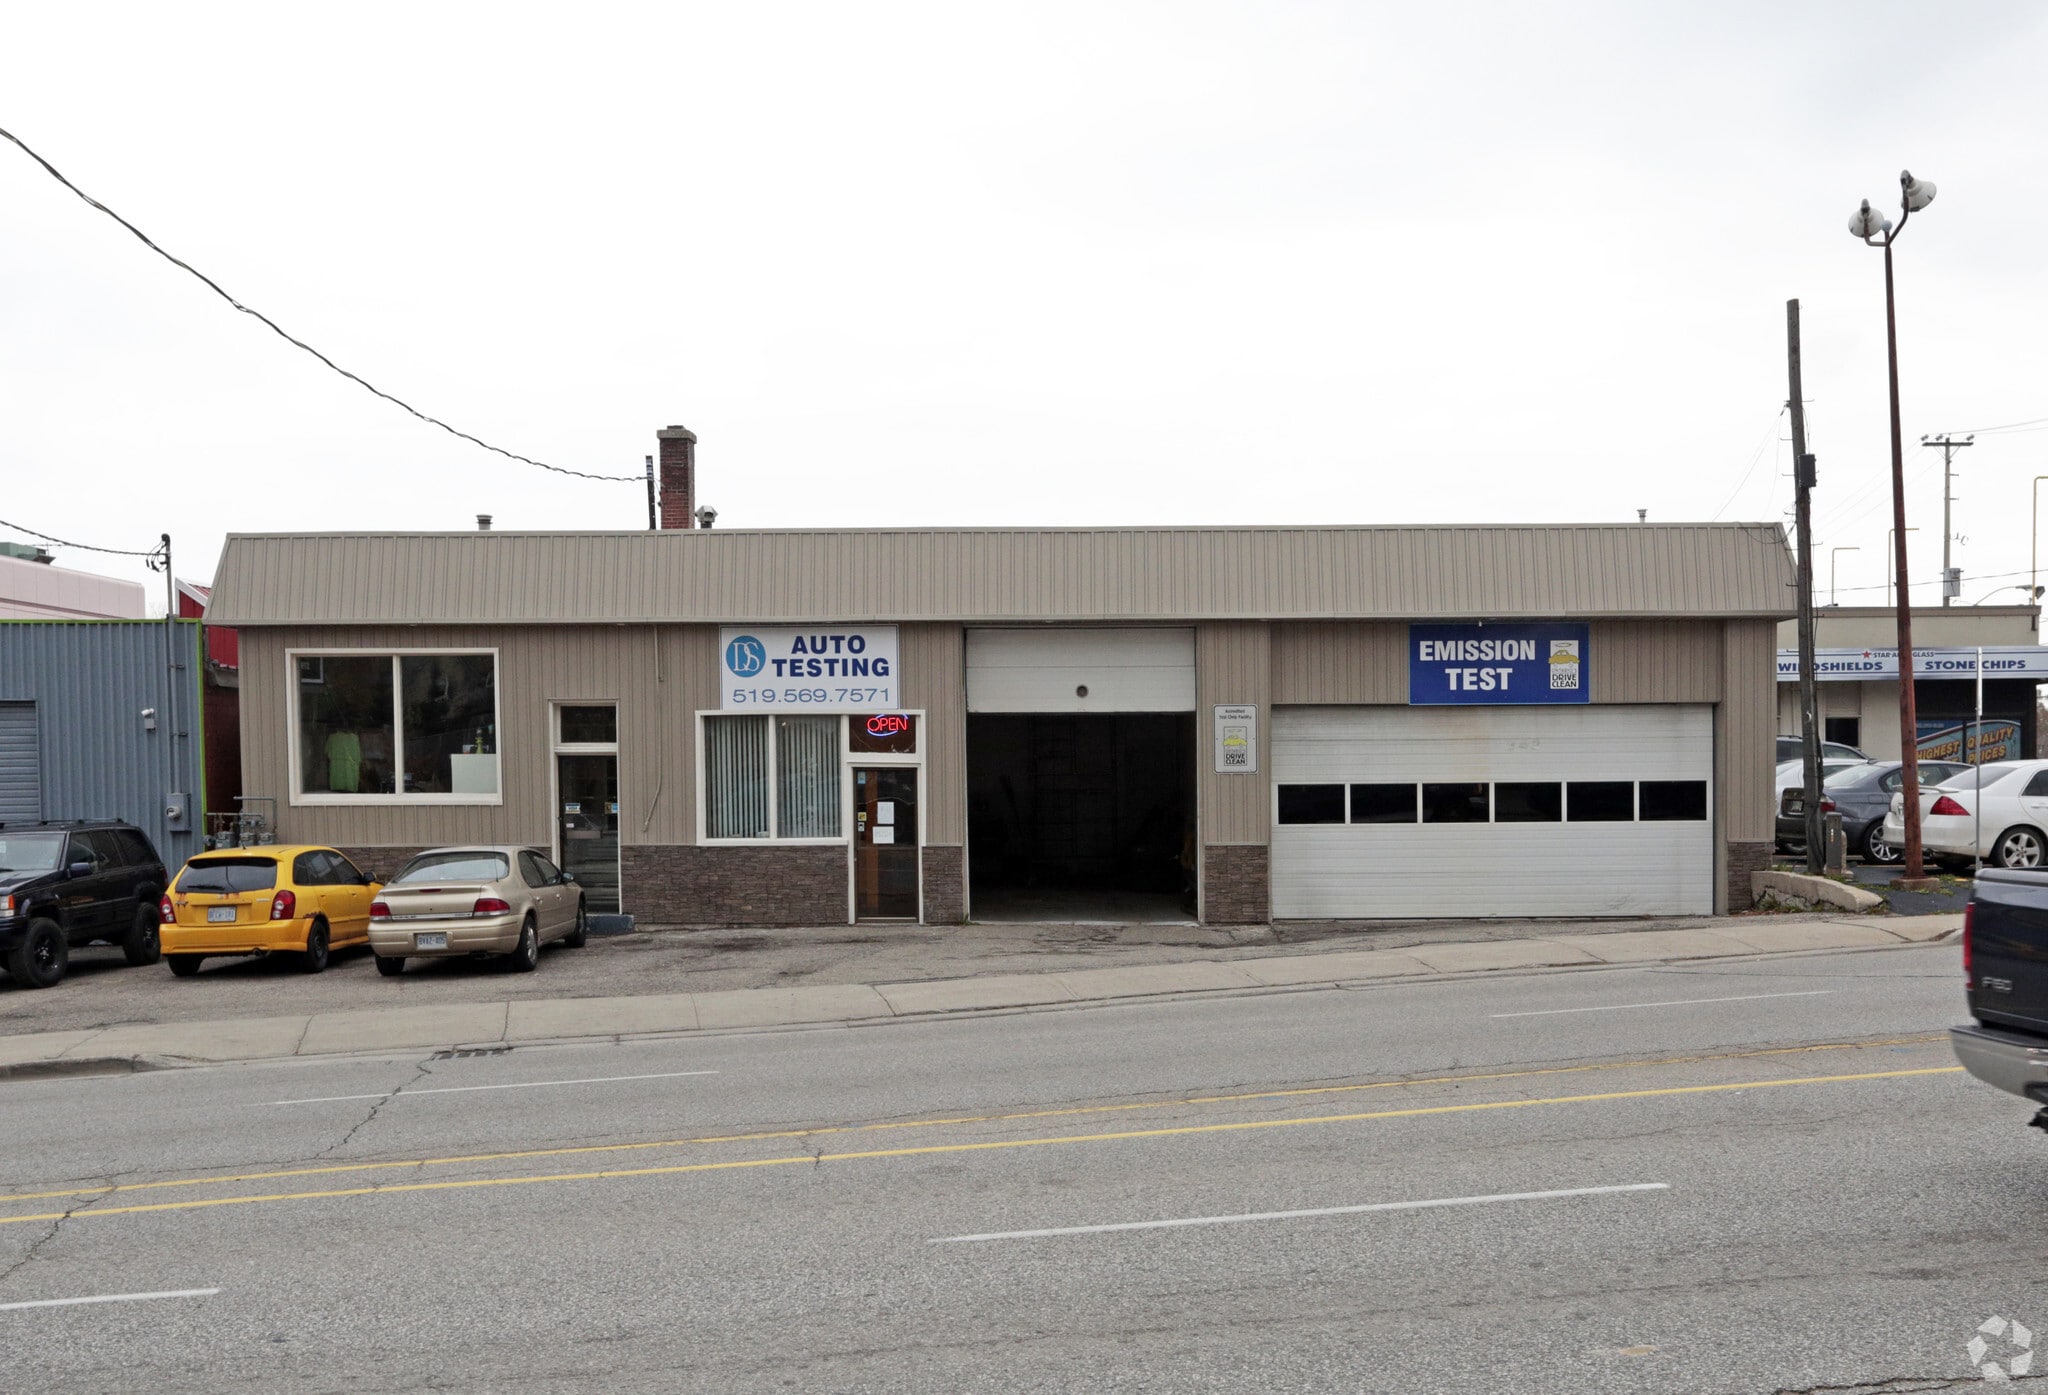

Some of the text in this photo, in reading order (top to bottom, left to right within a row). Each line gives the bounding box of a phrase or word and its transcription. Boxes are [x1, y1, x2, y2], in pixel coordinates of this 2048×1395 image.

[791, 634, 866, 655] AUTO
[1419, 639, 1536, 662] EMISSION
[771, 657, 890, 678] TESTING
[1925, 660, 1976, 670] STONE
[1981, 660, 2026, 669] CHIPS
[1445, 667, 1514, 691] TEST
[1551, 680, 1577, 688] CLEAN
[1552, 673, 1577, 681] DRIVE
[732, 688, 890, 703] 519.569.7571
[867, 716, 908, 732] OPEN
[1917, 727, 2014, 760] HIGHEST QALITY
[1967, 745, 2007, 765] PICES
